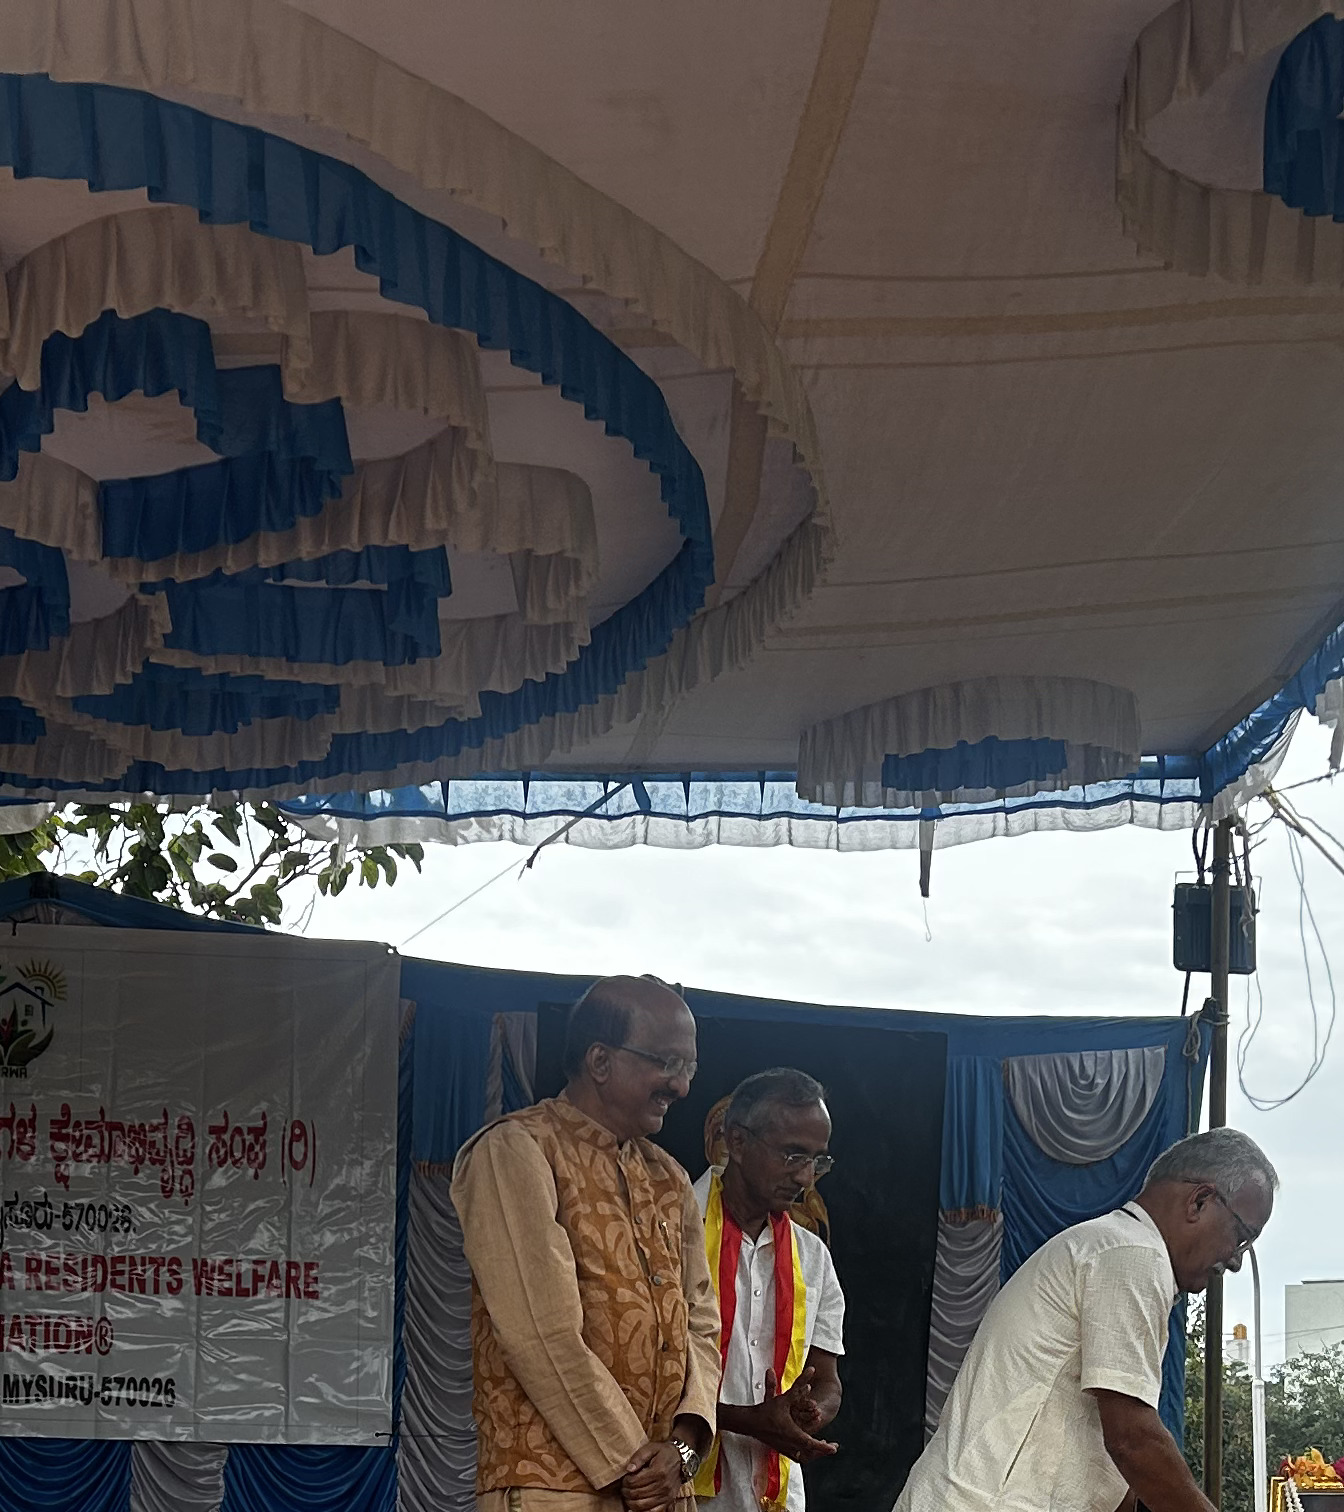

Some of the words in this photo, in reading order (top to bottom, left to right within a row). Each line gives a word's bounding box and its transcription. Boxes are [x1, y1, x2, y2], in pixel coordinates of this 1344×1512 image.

[207, 1109, 268, 1181] ಸಂಘ
[281, 1118, 316, 1189] (ರಿ)
[24, 1252, 184, 1295] RESIDENTS
[192, 1257, 321, 1300] WELFARE
[2, 1373, 177, 1408] MYSURU-570026
